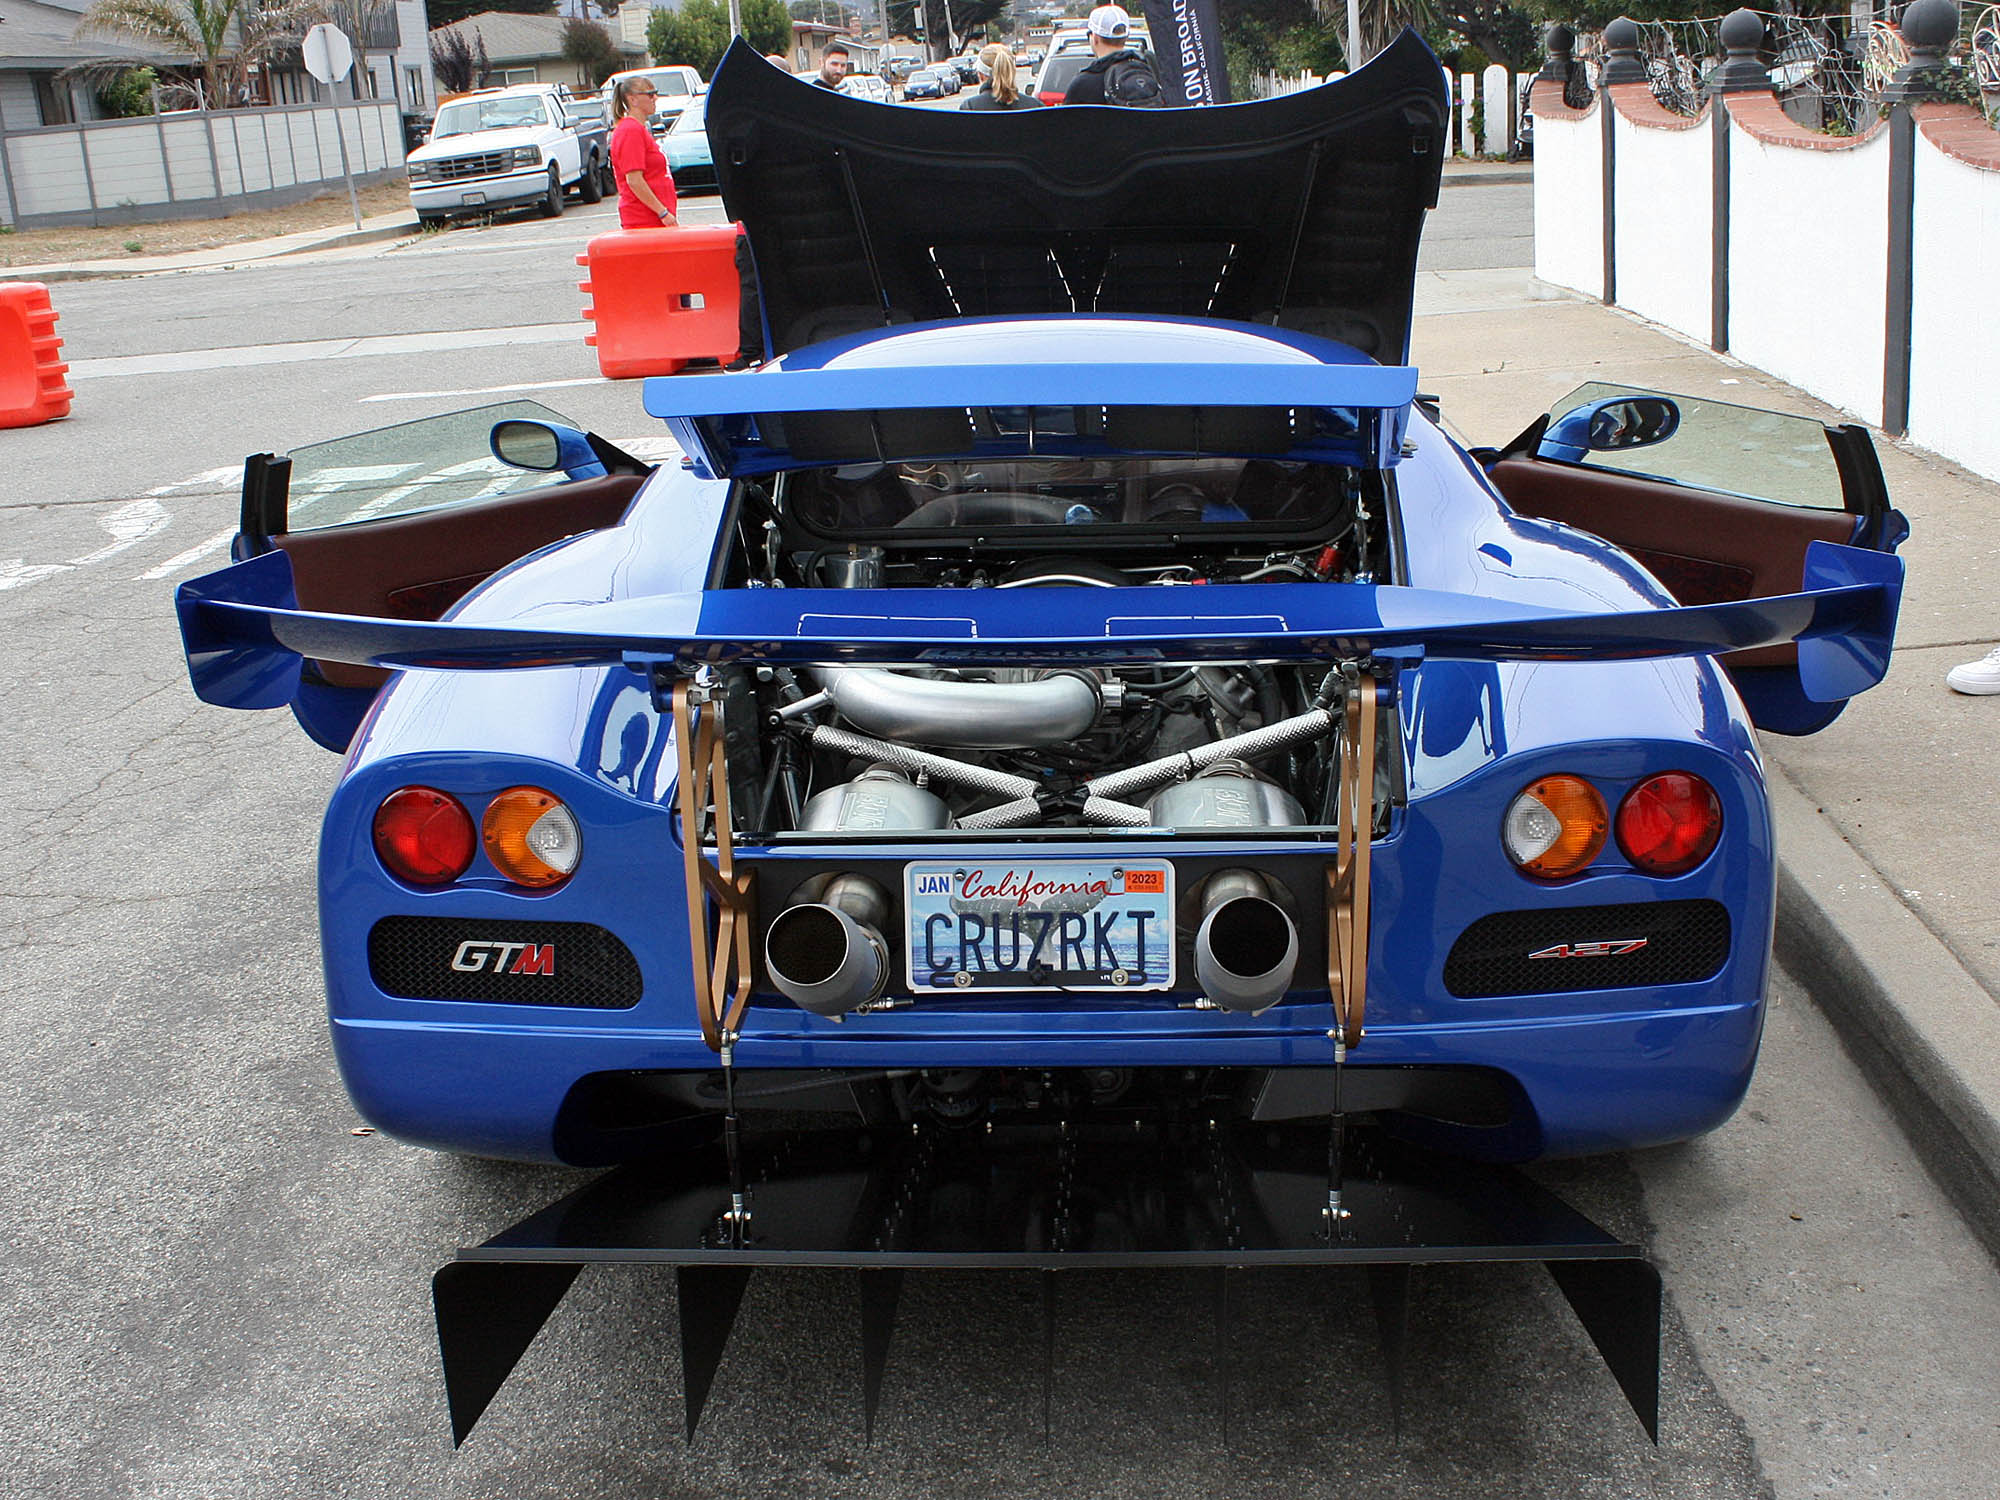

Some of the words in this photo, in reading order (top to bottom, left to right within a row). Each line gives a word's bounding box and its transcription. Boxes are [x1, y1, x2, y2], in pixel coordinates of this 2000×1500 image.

[1190, 9, 1206, 68] CALIFORNIA
[1184, 69, 1203, 100] ON
[918, 876, 950, 893] JAN
[961, 870, 1125, 906] California
[1131, 873, 1157, 885] 2023
[925, 911, 1155, 971] CRUZRKT
[1528, 937, 1647, 959] 427
[451, 940, 554, 976] GTM
